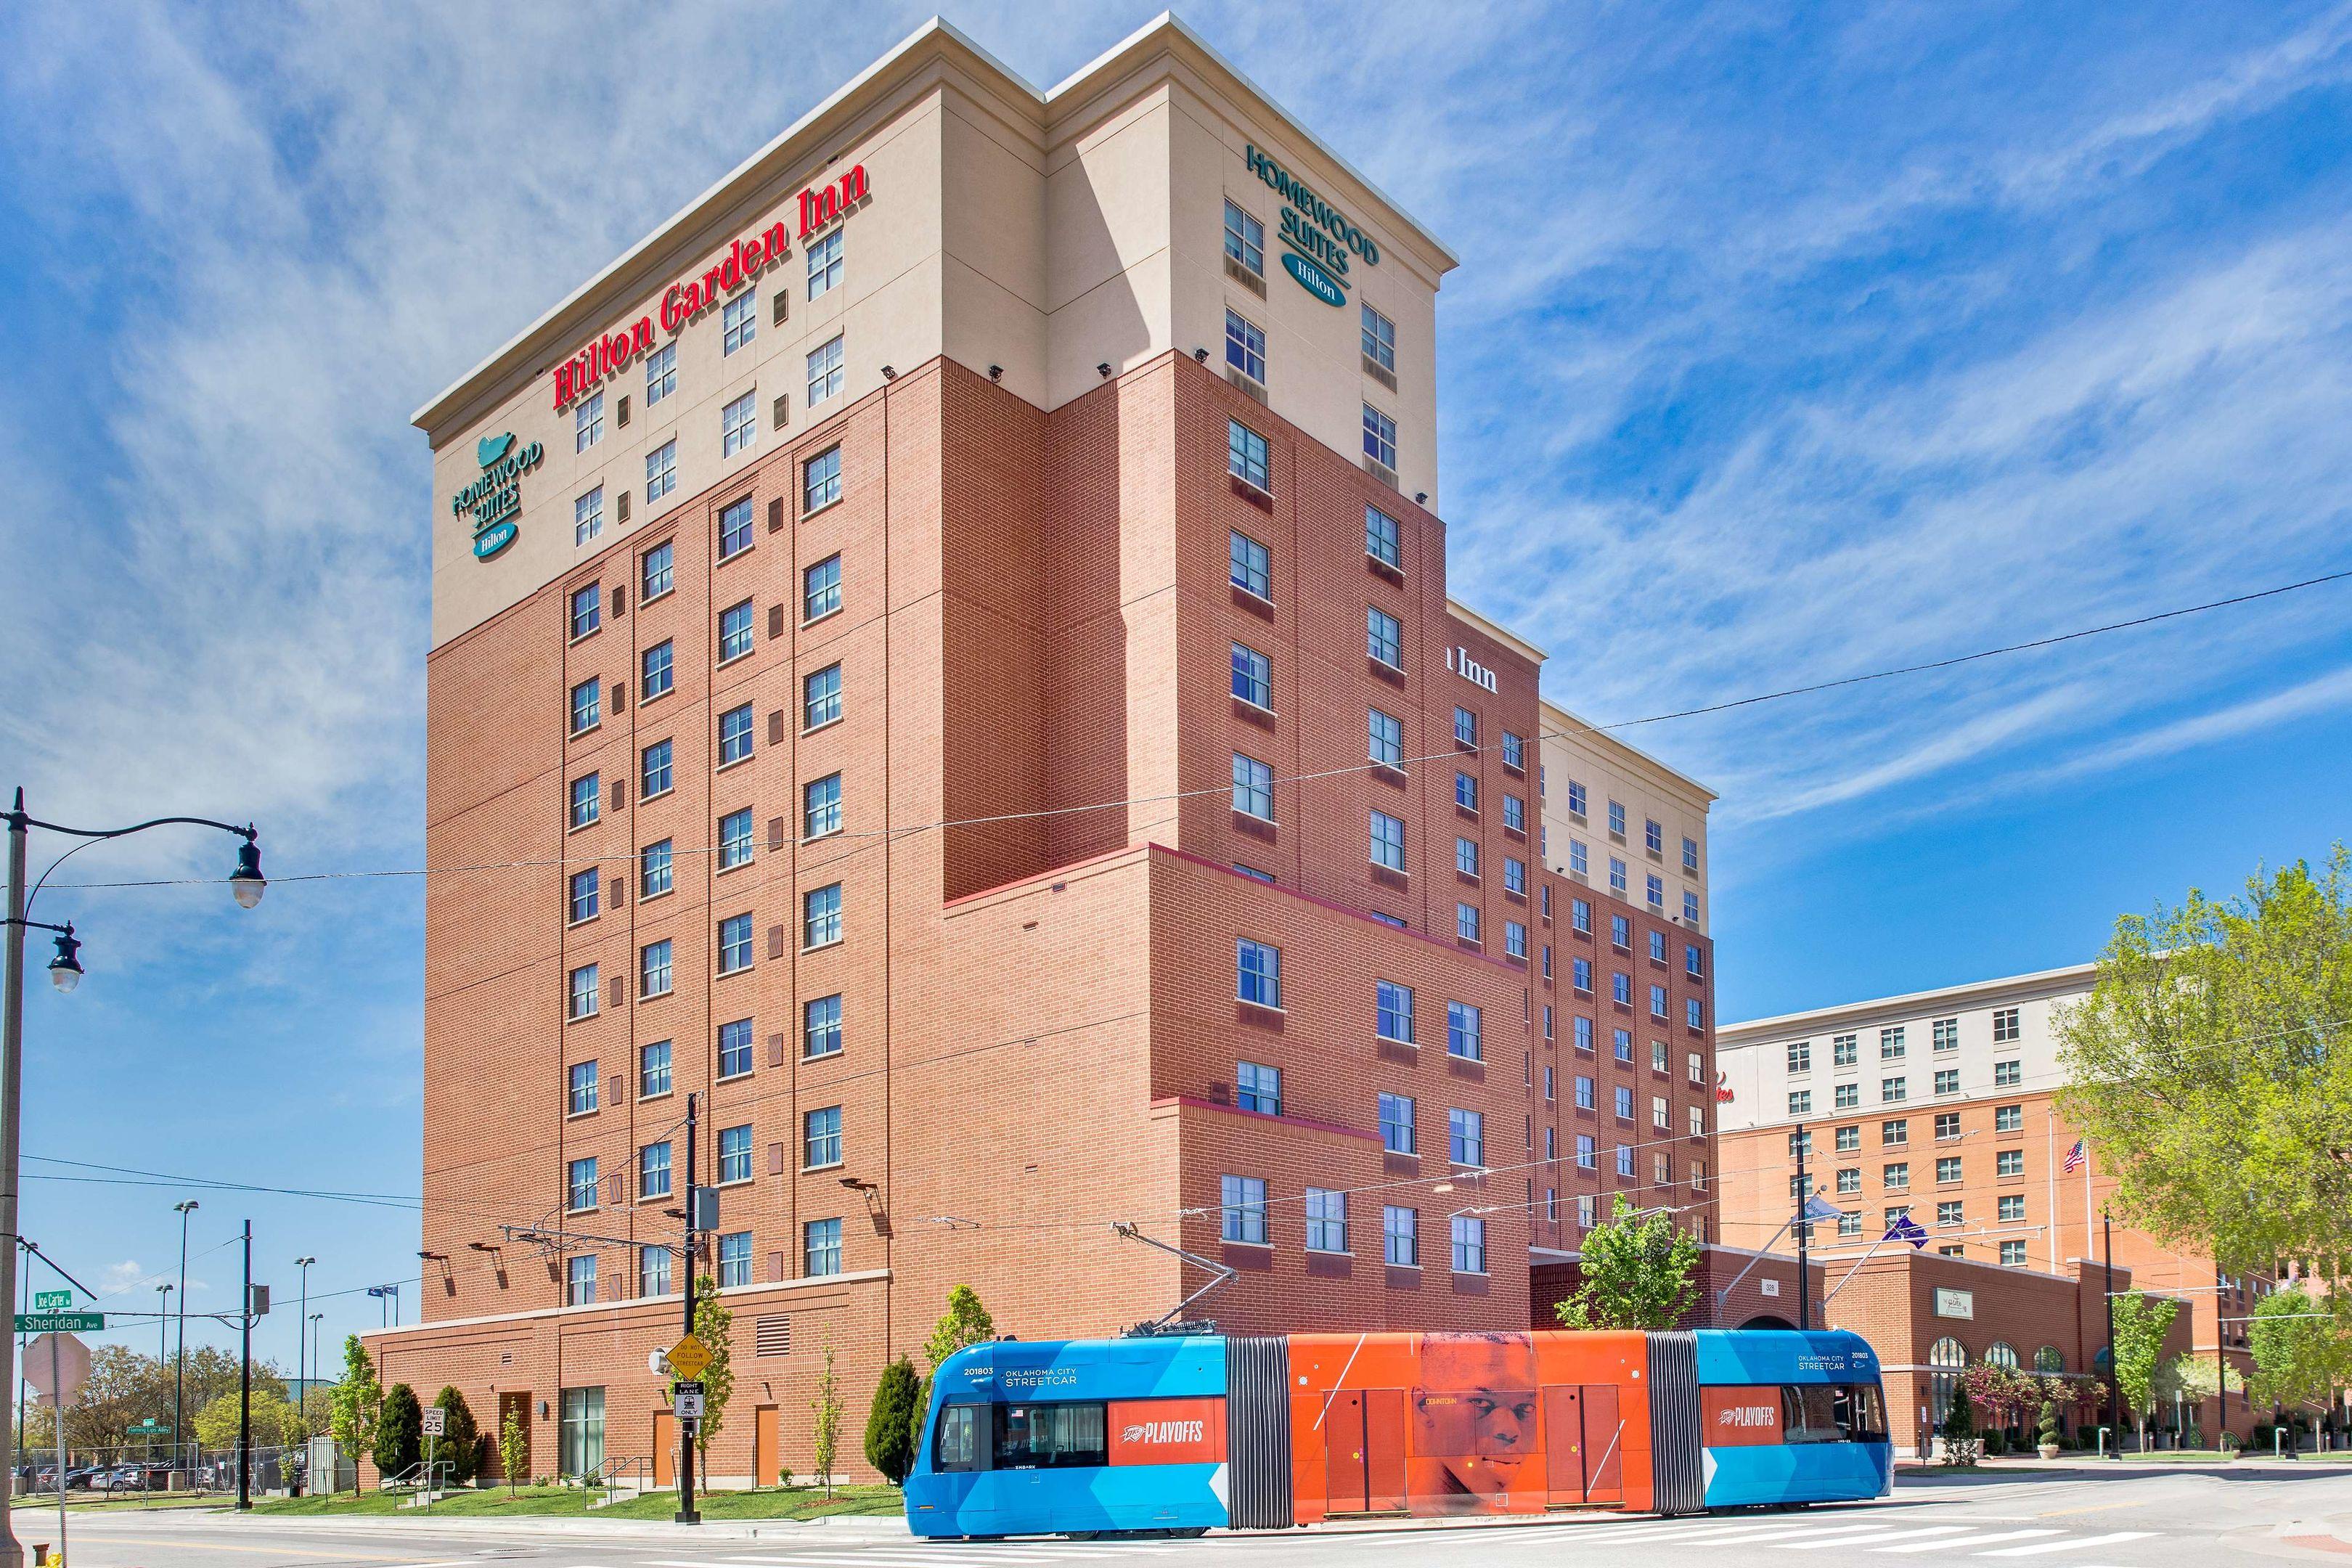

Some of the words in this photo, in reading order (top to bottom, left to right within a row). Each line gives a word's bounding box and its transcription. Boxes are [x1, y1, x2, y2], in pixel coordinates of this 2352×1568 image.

[1246, 144, 1379, 266] HOMEWOOD
[1280, 206, 1350, 275] SUITES
[553, 317, 653, 411] Hilton
[661, 221, 788, 331] Garden
[797, 165, 867, 240] Inn
[1297, 260, 1336, 301] Hilton
[452, 441, 544, 516] HOMEWOOD
[473, 481, 521, 528] SUITES
[481, 529, 507, 552] Hilton
[1456, 645, 1498, 695] Inn
[37, 1294, 47, 1307] Joe
[48, 1294, 65, 1307] Carter
[25, 1316, 81, 1330] Sheridan
[964, 1367, 994, 1376] 201803
[1005, 1376, 1077, 1387] STREETCAR
[425, 1421, 442, 1432] 25
[1735, 1406, 1774, 1426] PLAYOFFS
[1144, 1421, 1203, 1444] PLAYOFFS
